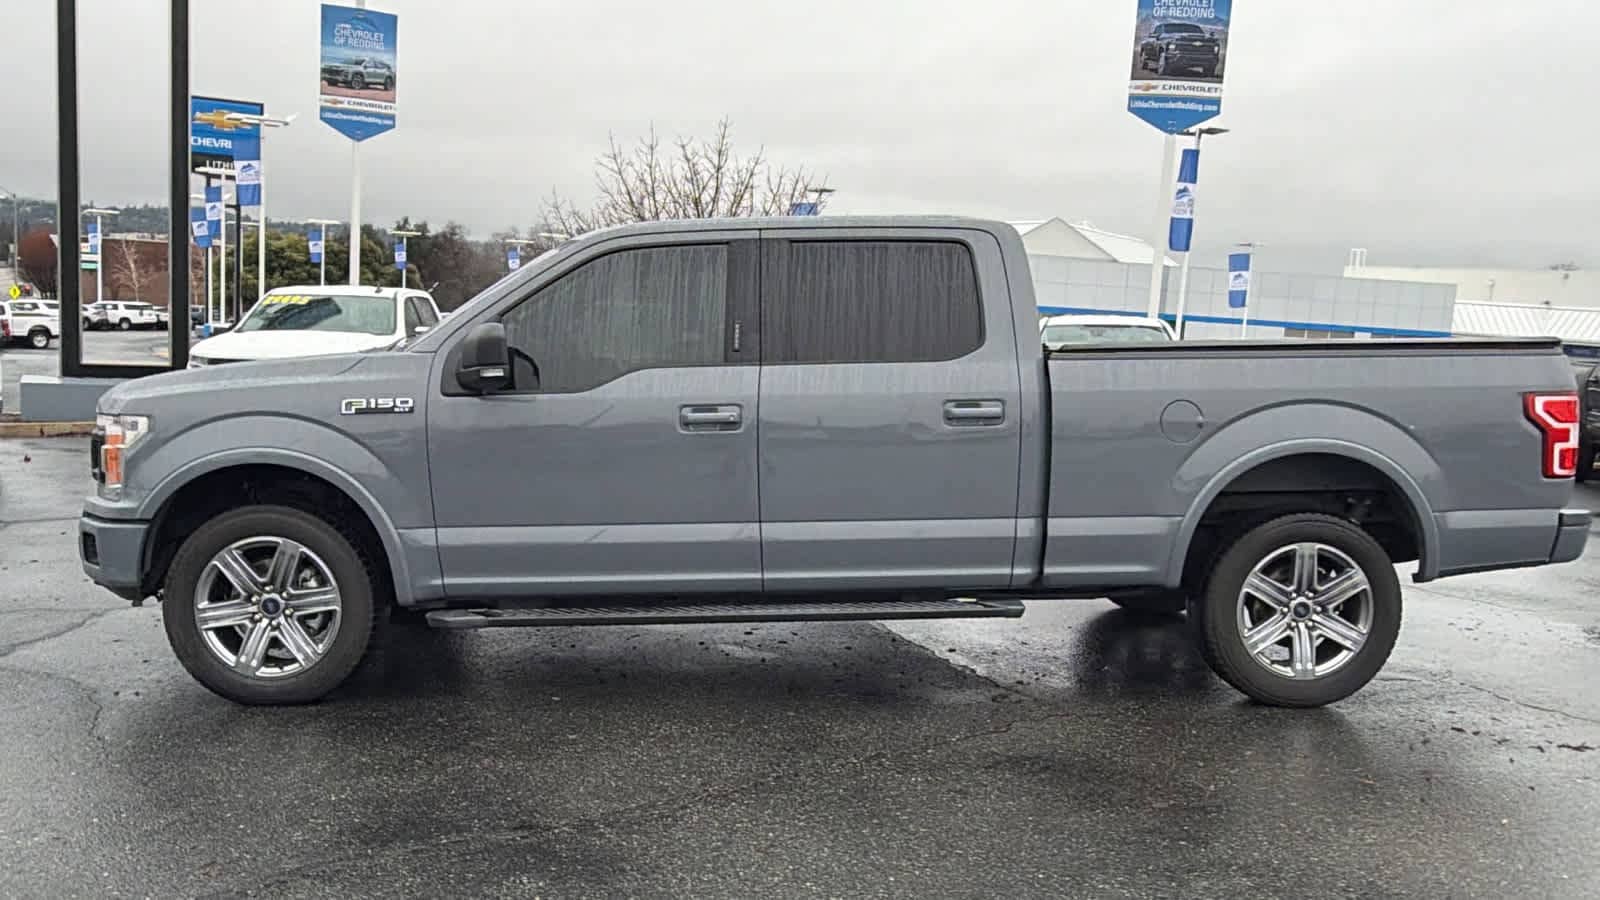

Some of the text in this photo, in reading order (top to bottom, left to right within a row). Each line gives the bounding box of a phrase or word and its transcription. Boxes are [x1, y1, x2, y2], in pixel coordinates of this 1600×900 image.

[1152, 6, 1215, 19] OF REDDING
[334, 28, 385, 42] CHEVROLET
[348, 38, 385, 50] REDDING
[1161, 83, 1219, 94] CHEVROLET
[346, 99, 393, 111] CHEVROLET
